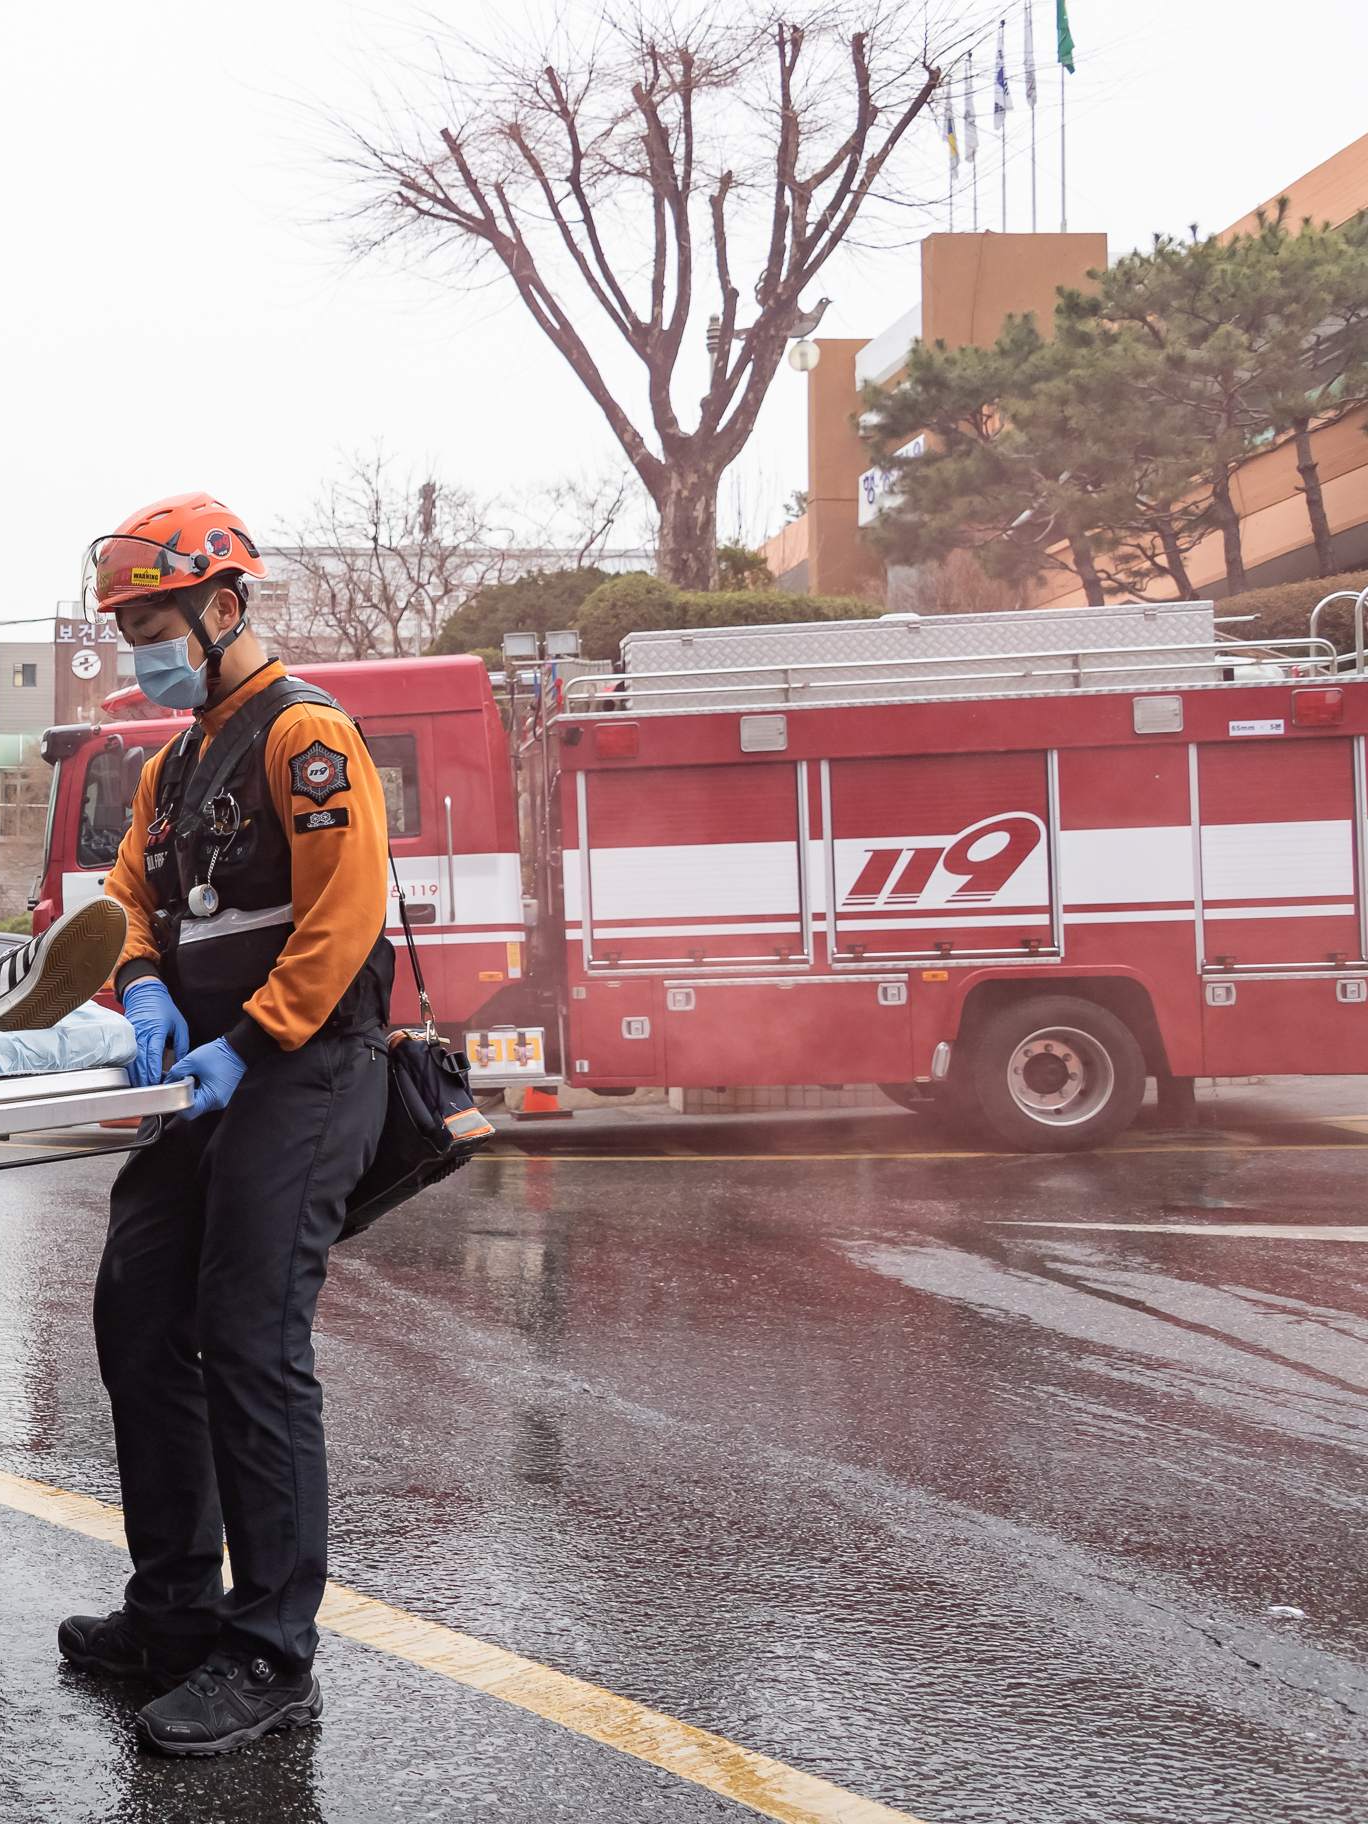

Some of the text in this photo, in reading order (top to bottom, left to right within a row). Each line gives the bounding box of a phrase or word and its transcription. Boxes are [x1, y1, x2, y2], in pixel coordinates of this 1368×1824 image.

[214, 534, 230, 551] 119
[133, 573, 158, 581] WARNING
[56, 624, 118, 646] 보건소
[309, 766, 328, 776] 119
[841, 816, 1041, 906] 119
[410, 884, 438, 897] 119
